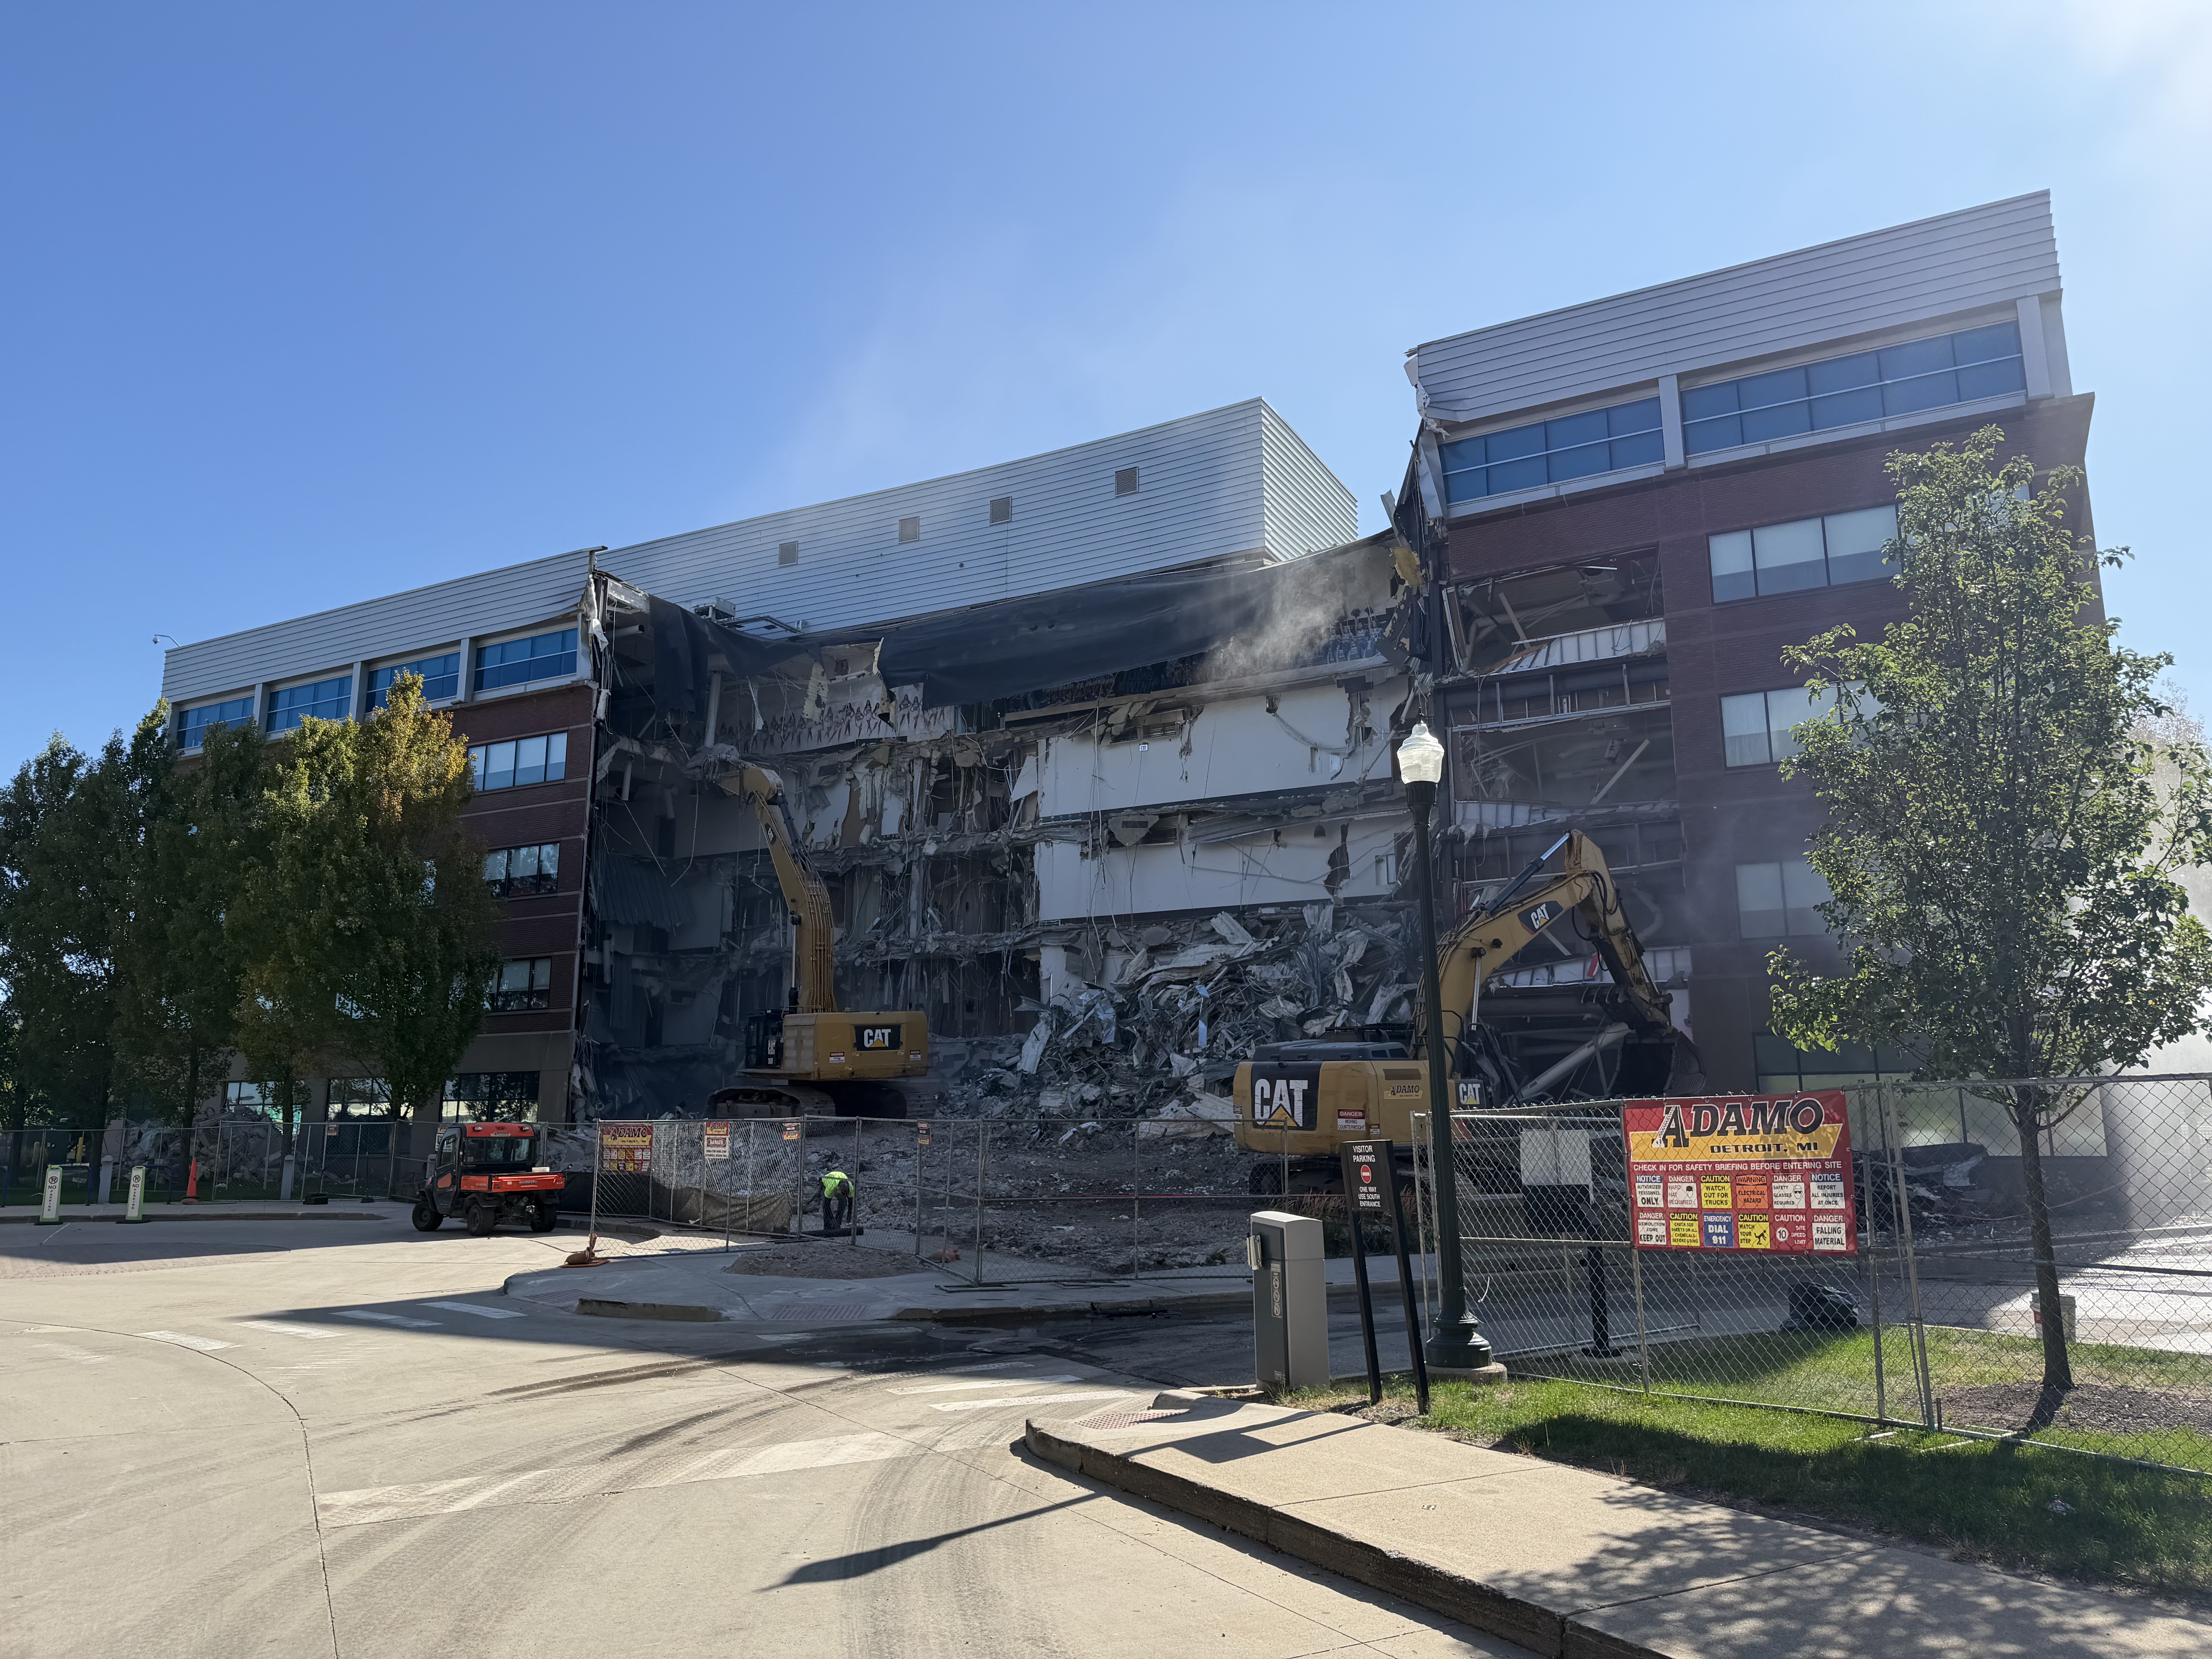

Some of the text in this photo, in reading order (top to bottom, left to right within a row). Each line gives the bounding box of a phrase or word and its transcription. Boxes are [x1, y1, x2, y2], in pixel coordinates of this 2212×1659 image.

[1531, 903, 1549, 929] CAT
[864, 1029, 891, 1048] CAT
[1389, 1084, 1420, 1096] ADAMO
[1459, 1083, 1480, 1104] CAT
[1255, 1079, 1308, 1127] CAT
[1652, 1097, 1825, 1147] ADAMO
[1710, 1142, 1818, 1153] DETROIT, MI
[1708, 1224, 1728, 1233] DIAL
[1778, 1230, 1786, 1239] 10
[1656, 1234, 1665, 1242] OUT
[1712, 1235, 1726, 1244] 911
